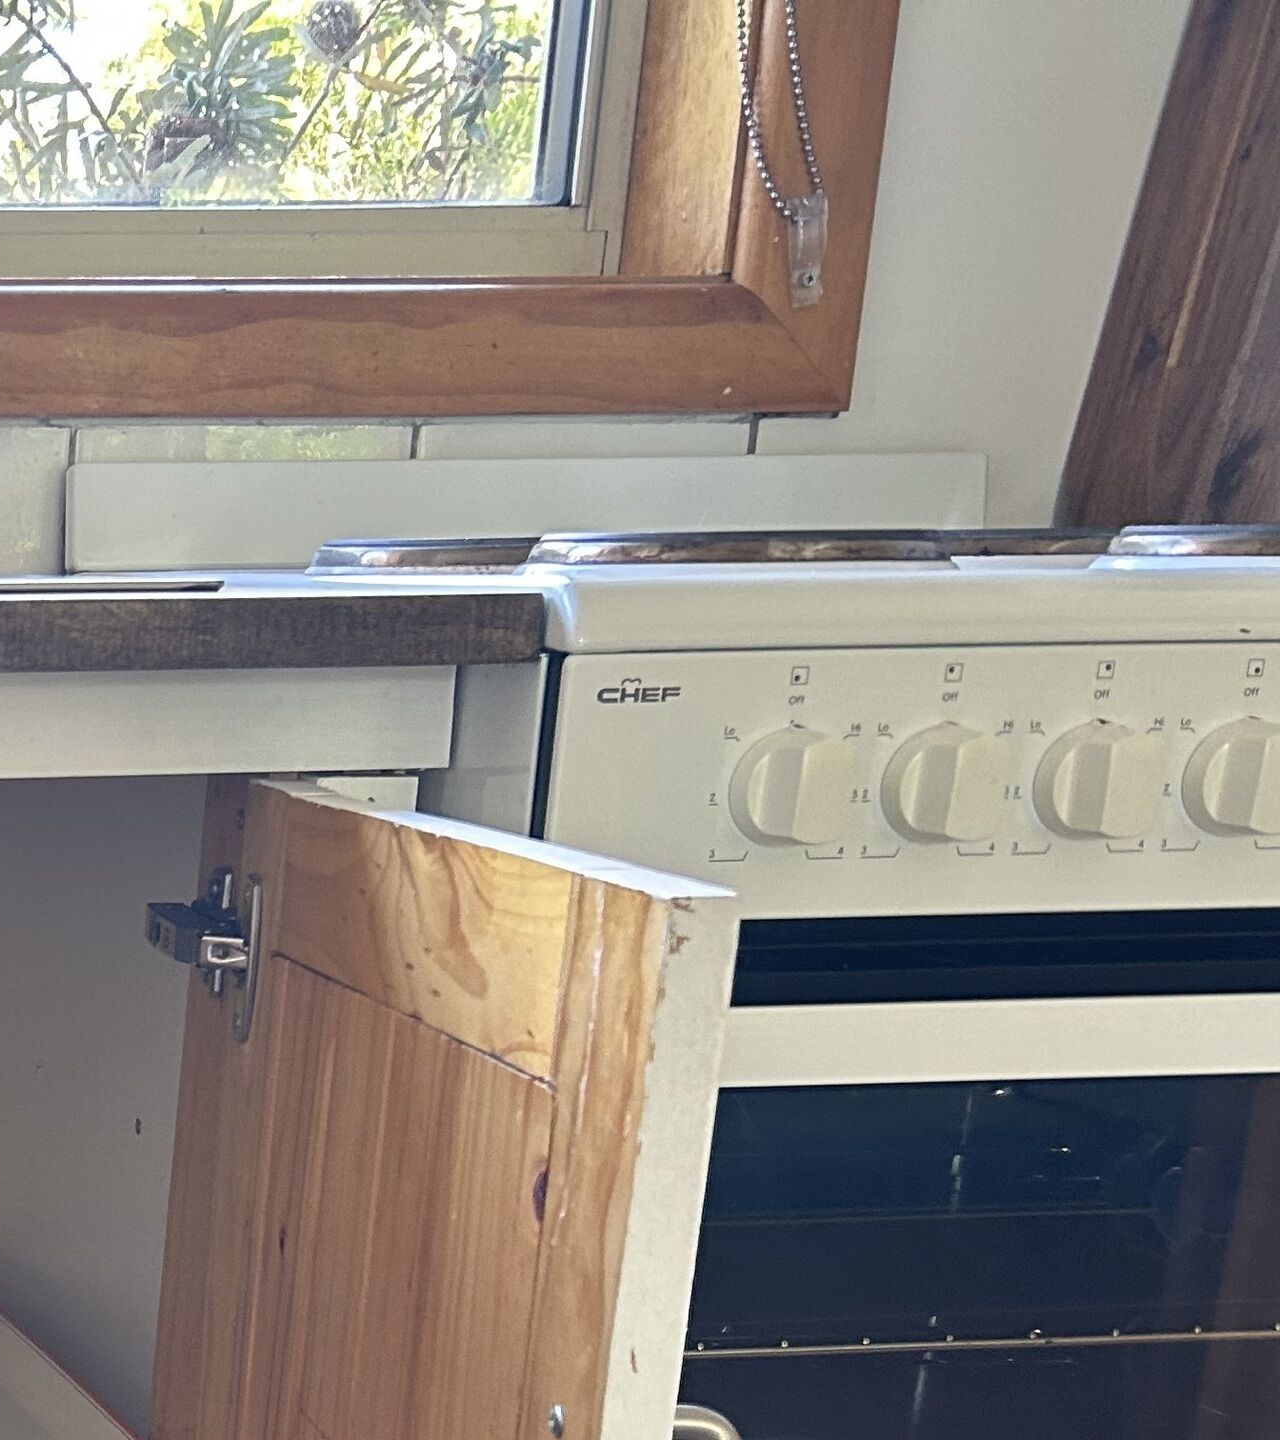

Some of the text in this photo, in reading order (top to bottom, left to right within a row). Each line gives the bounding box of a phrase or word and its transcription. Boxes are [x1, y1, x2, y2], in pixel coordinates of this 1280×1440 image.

[597, 686, 682, 704] CHEF
[942, 691, 959, 702] Off
[1094, 689, 1110, 700] Off
[1243, 687, 1260, 697] Off
[1180, 717, 1192, 726] Lo
[724, 726, 735, 735] Lo
[878, 723, 889, 732] Lo
